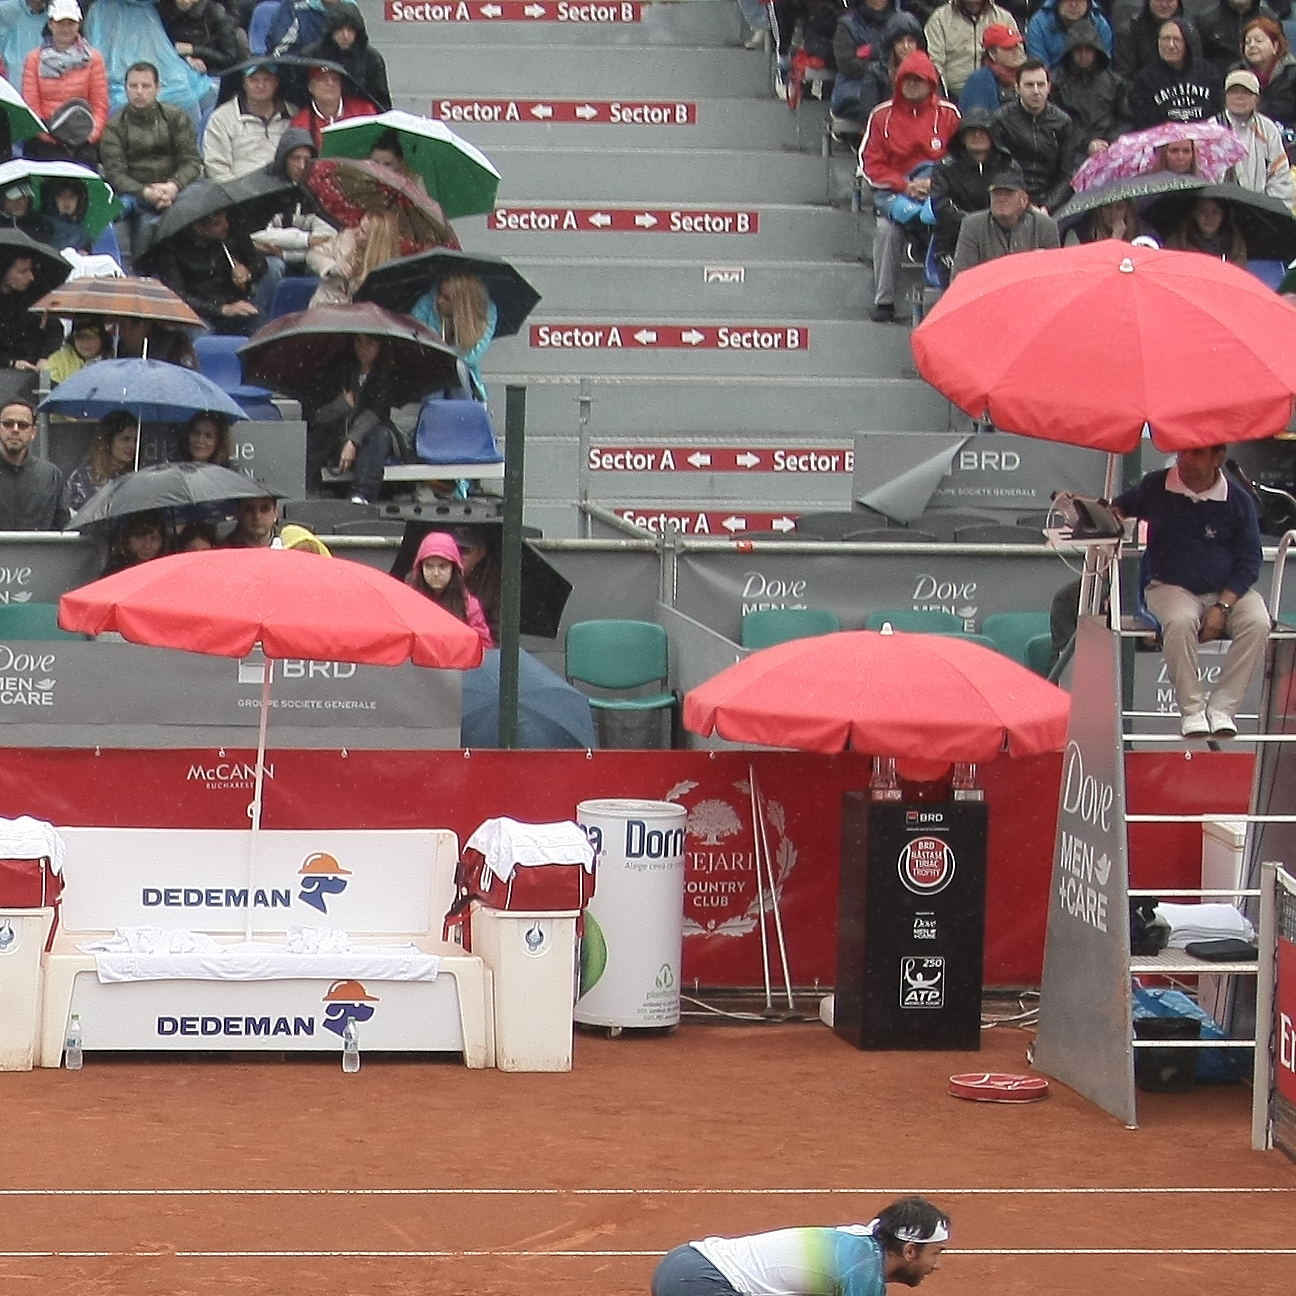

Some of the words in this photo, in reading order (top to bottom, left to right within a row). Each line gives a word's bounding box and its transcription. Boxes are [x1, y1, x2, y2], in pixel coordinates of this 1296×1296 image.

[391, 2, 452, 21] Sector
[455, 3, 470, 20] A
[557, 2, 618, 21] Sector
[621, 3, 634, 21] B
[439, 101, 503, 121] Sector
[506, 102, 520, 121] A
[609, 103, 672, 123] Sector
[675, 104, 688, 123] B
[495, 209, 559, 230] Sector
[563, 211, 578, 229] A
[669, 212, 733, 233] Sector
[737, 214, 750, 233] B
[538, 327, 603, 347] Sector
[607, 328, 622, 347] A
[717, 328, 782, 348] Sector
[786, 329, 799, 348] B
[589, 449, 657, 471] Sector
[660, 451, 675, 470] A
[773, 451, 841, 472] Sector
[960, 452, 1021, 471] BRD
[742, 572, 807, 599] Dove
[913, 574, 977, 600] Dove
[324, 700, 377, 710] GENERALE
[1063, 740, 1113, 832] Dove
[625, 820, 686, 858] Dorn
[1061, 831, 1094, 883] MEN
[142, 888, 292, 908] DEDEMAN
[684, 881, 746, 894] OUNTRY
[693, 895, 729, 907] CLUB
[1059, 876, 1108, 933] +CARE
[922, 960, 942, 968] 250
[905, 991, 940, 1002] ATP
[158, 1016, 316, 1036] DEDEMAN
